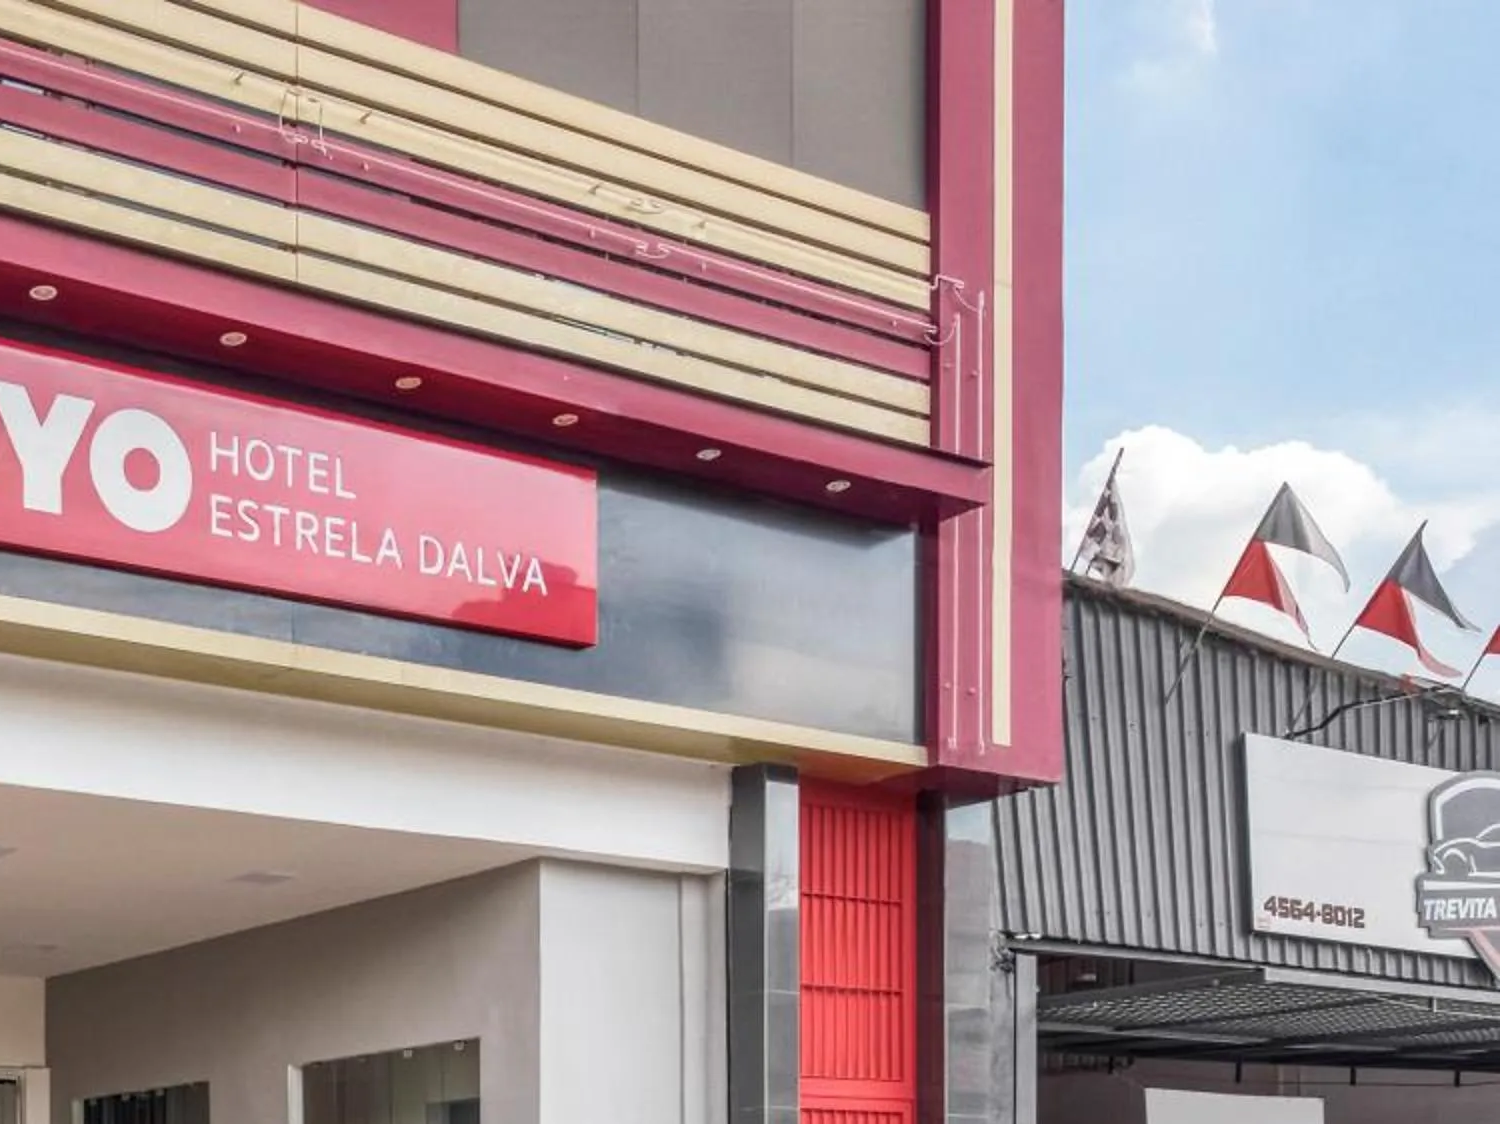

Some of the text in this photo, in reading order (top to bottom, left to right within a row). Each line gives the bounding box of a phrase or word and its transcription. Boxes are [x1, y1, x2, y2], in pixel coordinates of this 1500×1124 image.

[210, 431, 357, 499] HOTEL
[210, 494, 548, 596] ESTRELA DALVA
[1423, 896, 1498, 921] TREVITA
